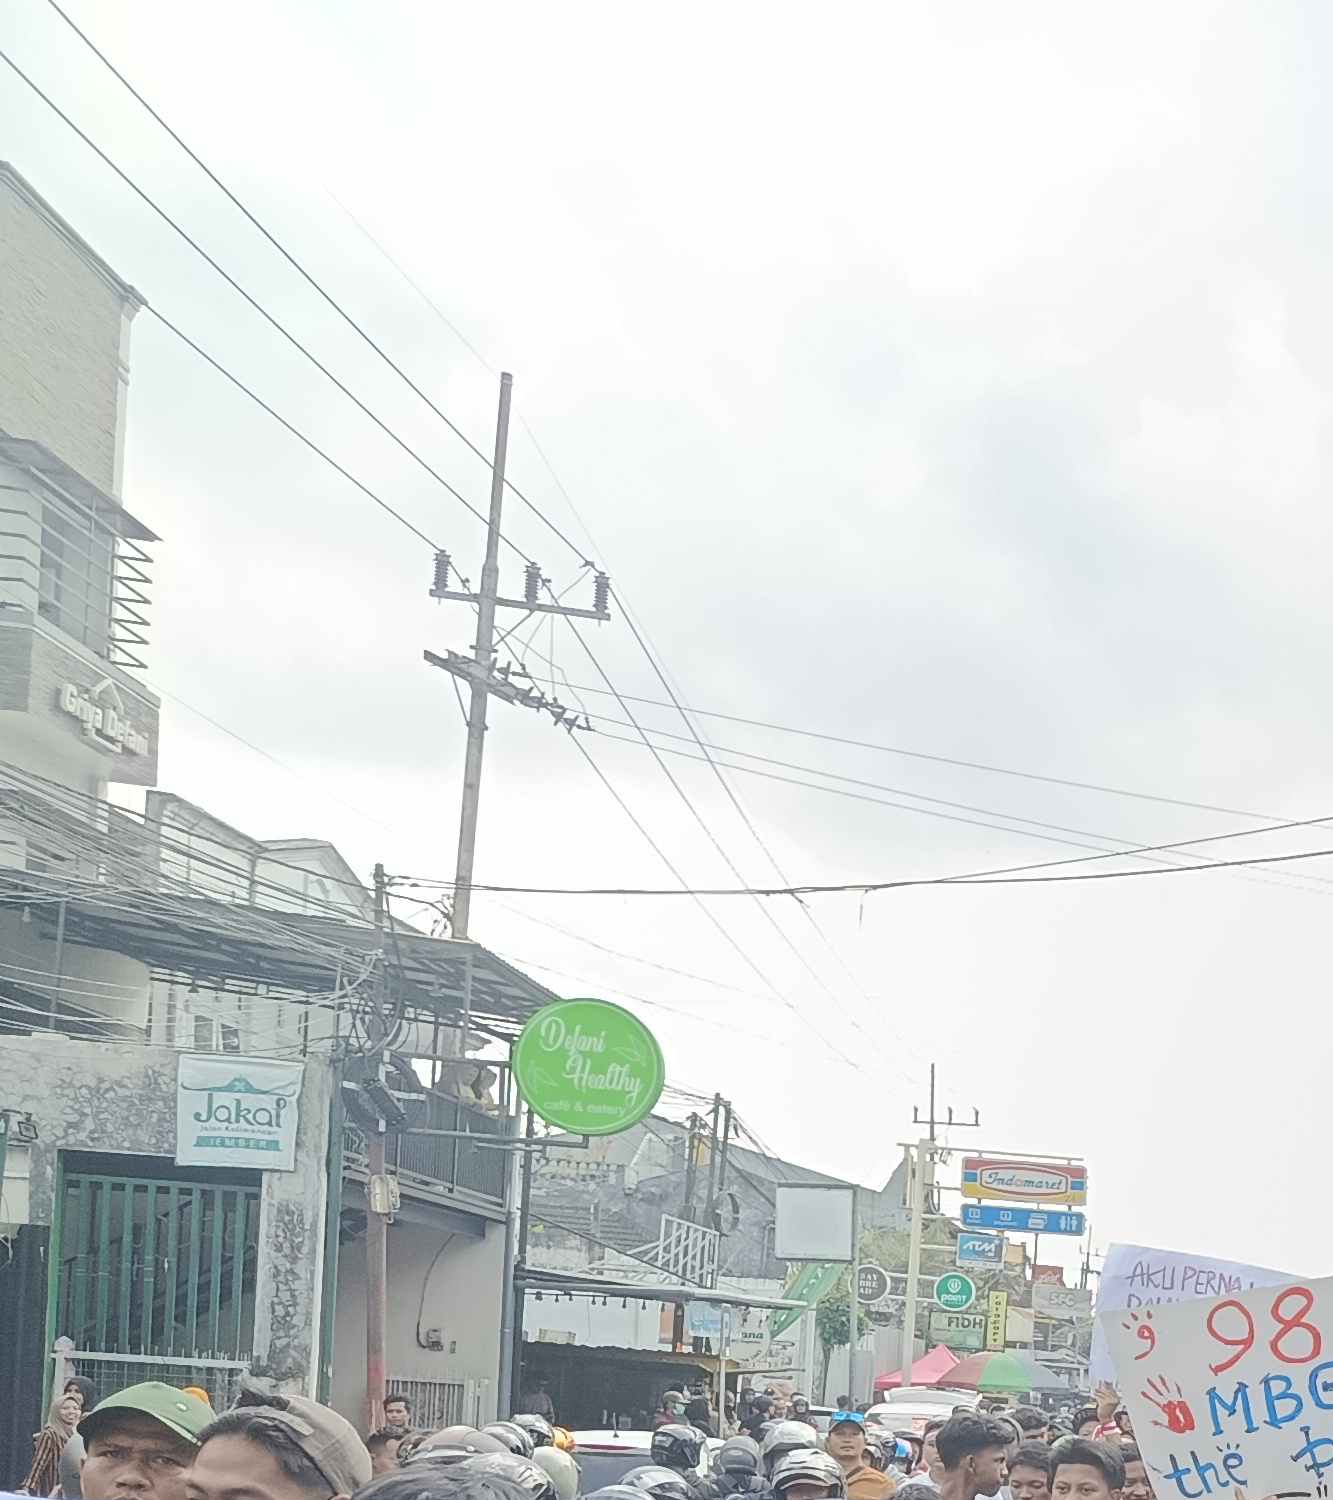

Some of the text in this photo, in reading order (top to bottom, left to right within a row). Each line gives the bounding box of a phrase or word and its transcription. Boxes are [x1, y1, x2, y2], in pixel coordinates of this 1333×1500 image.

[561, 1055, 641, 1105] Healthy
[988, 1171, 1064, 1191] Indomaret
[1126, 1260, 1254, 1296] AKU PERNA
[1206, 1286, 1322, 1376] 98
[1163, 1446, 1248, 1498] the
